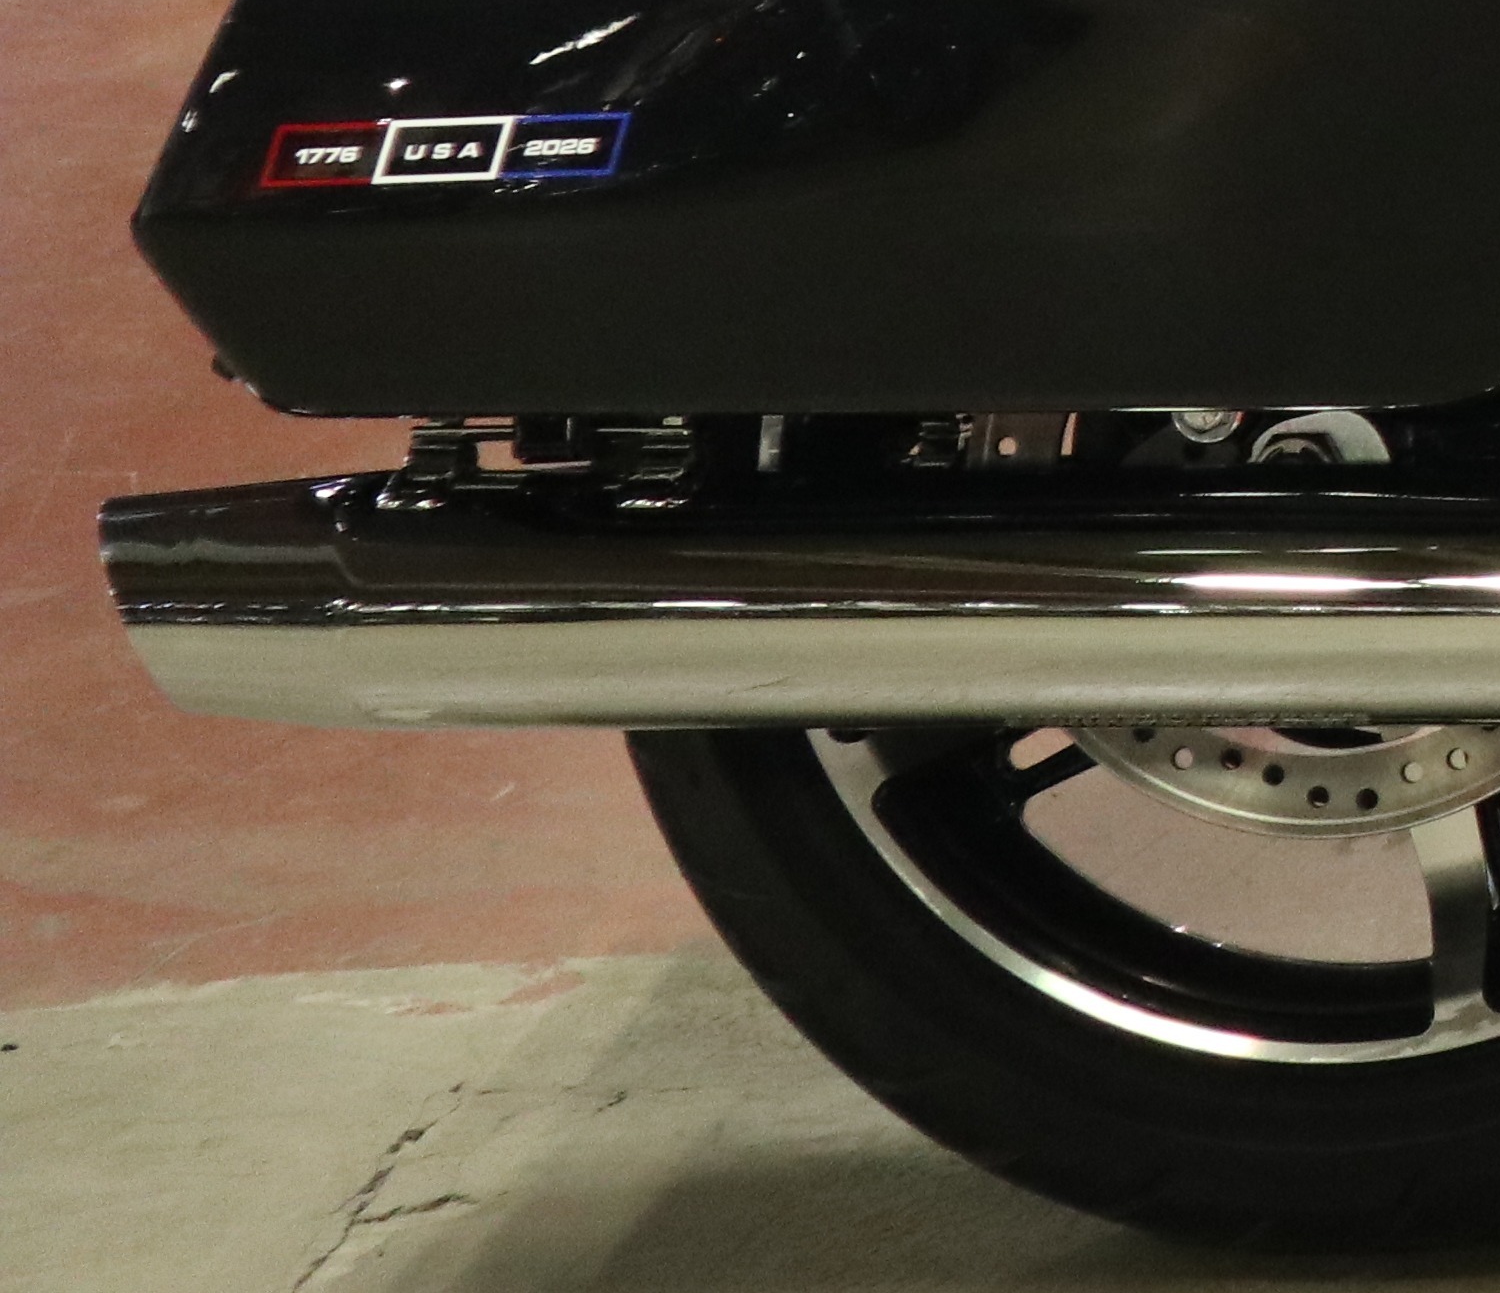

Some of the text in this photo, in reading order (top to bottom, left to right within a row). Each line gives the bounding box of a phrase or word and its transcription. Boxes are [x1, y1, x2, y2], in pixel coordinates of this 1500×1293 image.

[294, 137, 599, 165] 1776 USA 2026
